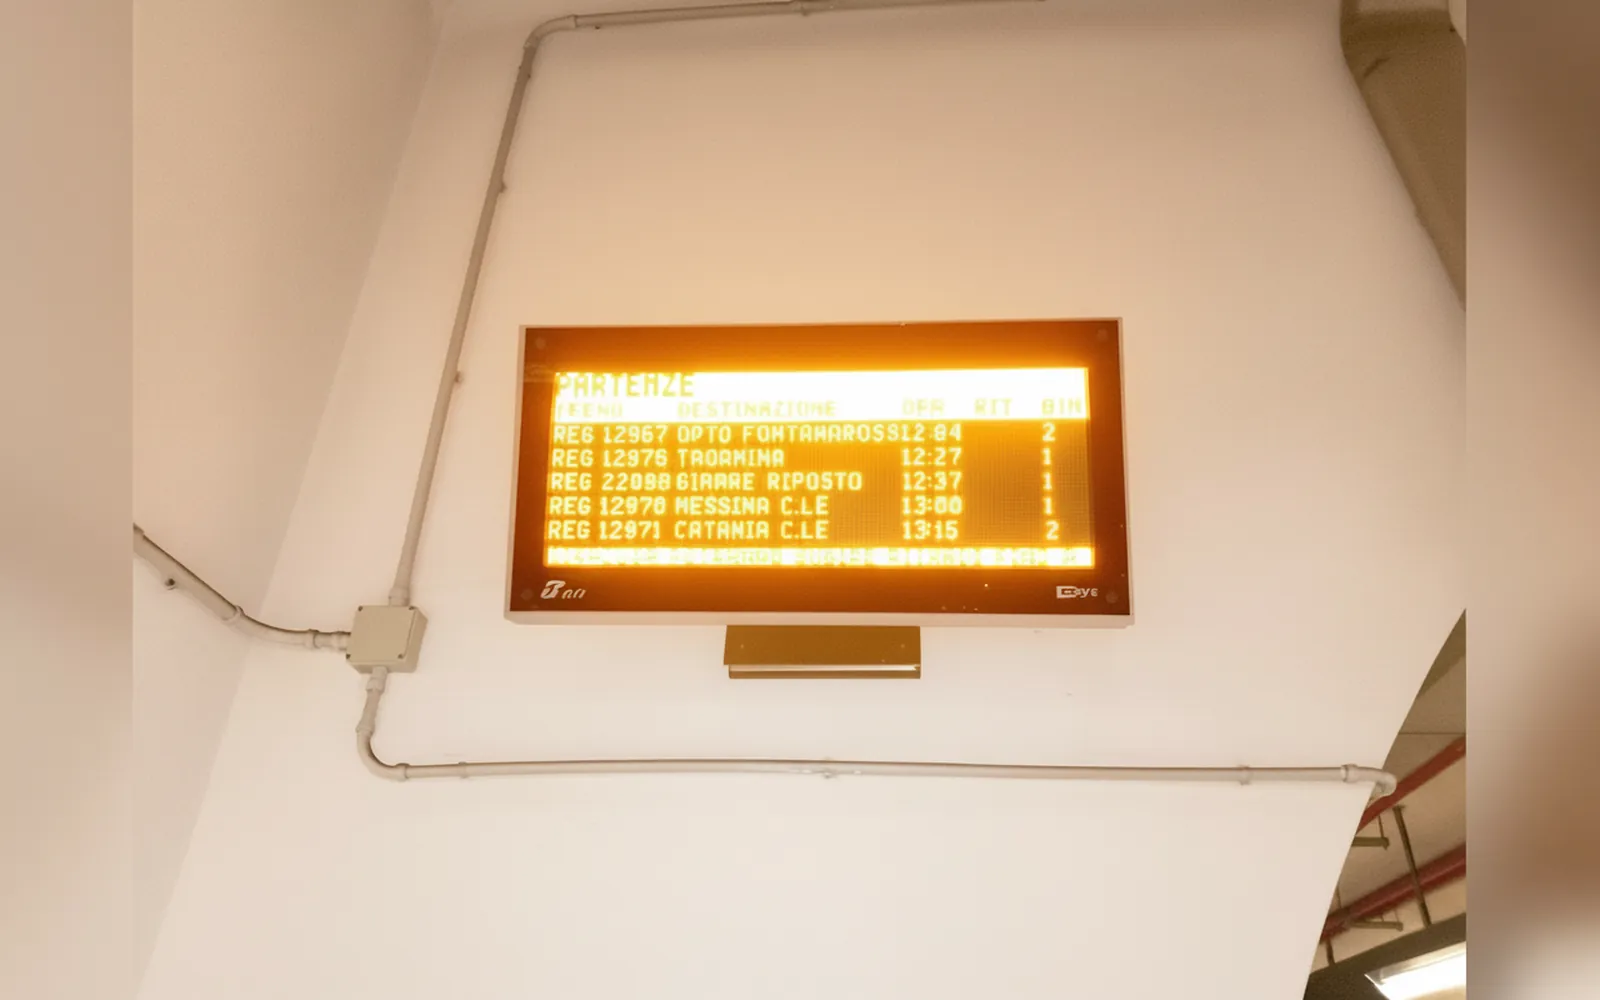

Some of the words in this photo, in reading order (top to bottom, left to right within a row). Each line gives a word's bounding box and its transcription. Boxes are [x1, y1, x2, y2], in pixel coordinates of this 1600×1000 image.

[553, 425, 594, 444] REG
[603, 424, 669, 444] 12967
[1042, 421, 1056, 442] 2
[552, 448, 593, 468] REG
[603, 448, 668, 468] 12976
[902, 446, 963, 466] 12:27
[1043, 447, 1052, 466] 1
[551, 472, 592, 491] REG
[767, 471, 863, 491] RIPOSTO
[902, 470, 963, 491] 12:37
[1043, 471, 1053, 491] 1
[549, 496, 592, 516] REG
[674, 496, 770, 516] MESSINA
[780, 495, 830, 516] C.LE
[1044, 496, 1053, 515] 1
[548, 520, 592, 539] REG
[599, 520, 661, 540] 12971
[673, 520, 769, 540] CATANIA
[780, 519, 830, 540] C.LE
[902, 519, 959, 540] 13:15
[1046, 520, 1060, 541] 2
